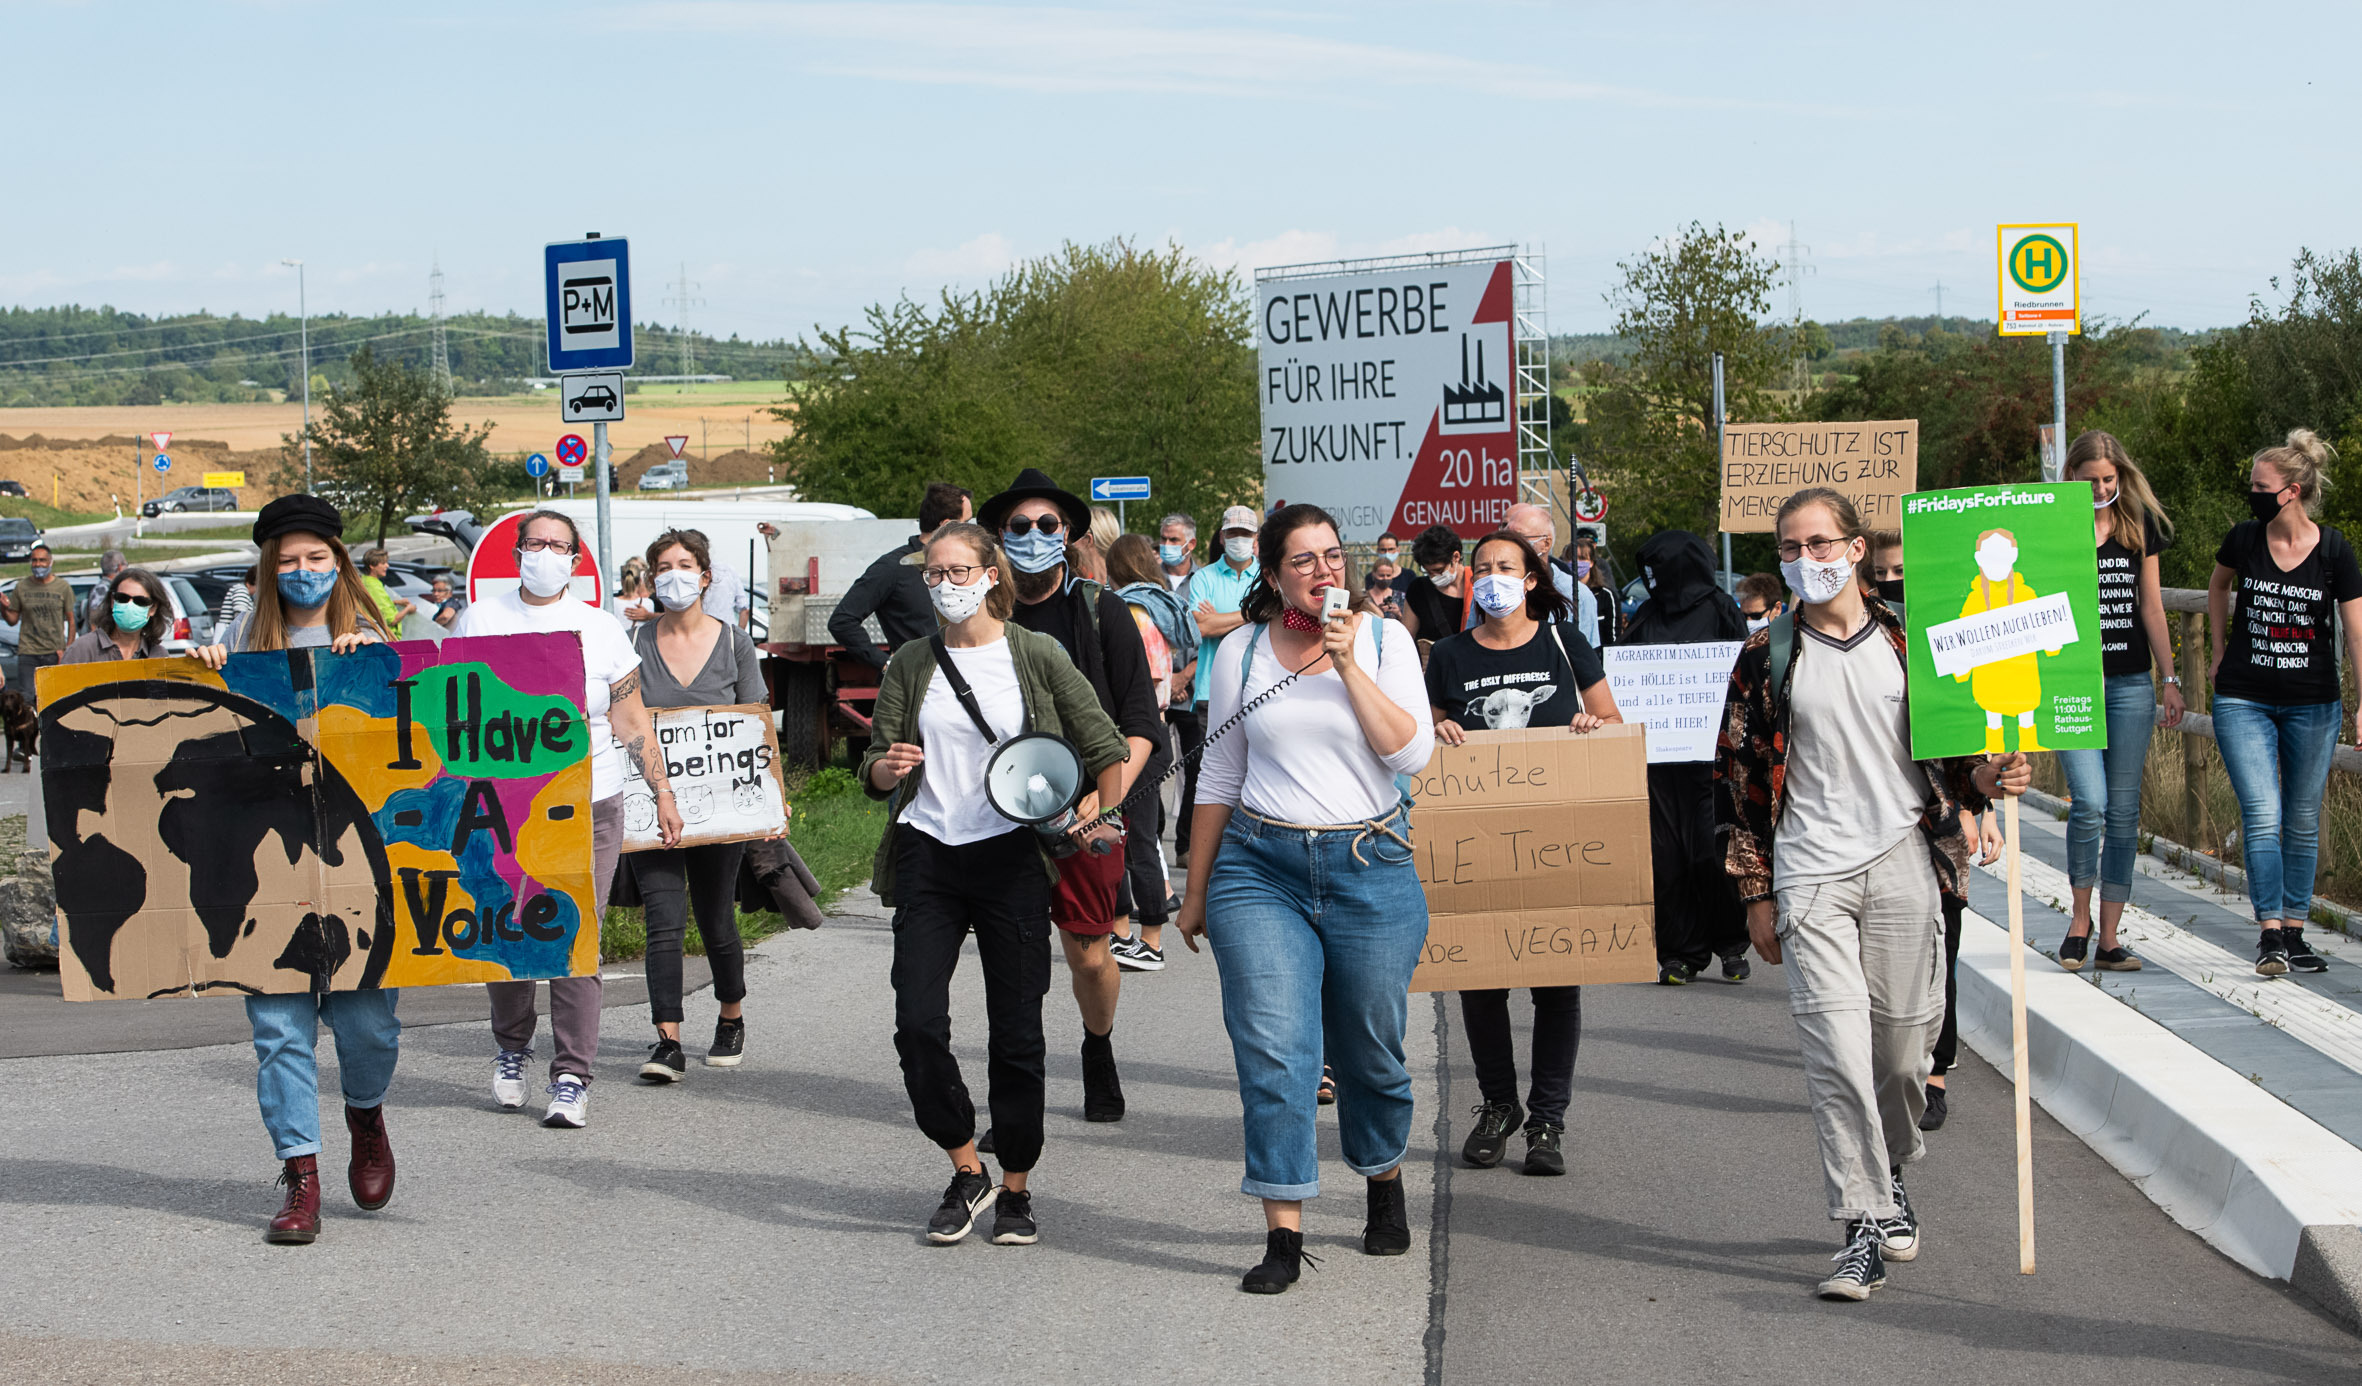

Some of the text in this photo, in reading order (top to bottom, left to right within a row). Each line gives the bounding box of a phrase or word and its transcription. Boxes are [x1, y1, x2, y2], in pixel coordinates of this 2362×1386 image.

[2026, 248, 2052, 279] H
[564, 286, 614, 324] P+M
[1266, 282, 1449, 344] GEWERBE
[1268, 358, 1396, 404] FÜR IHRE
[1270, 421, 1413, 465] ZUKUNFT.
[1726, 430, 1909, 457] TIERSCHUTZ IST
[1439, 447, 1513, 488] 20 ha
[1727, 459, 1900, 487] ERZIEHUNG ZUR
[1403, 500, 1466, 526] GENAU
[1908, 491, 2055, 514] #FridaysForFuture
[2099, 558, 2129, 568] UND DEN
[2101, 588, 2121, 599] KANN
[2244, 577, 2323, 601] SO LANGE MENSCHEN
[2111, 603, 2125, 614] WIE
[2262, 611, 2287, 623] NICHT
[2287, 601, 2307, 612] DASS
[1933, 604, 2068, 654] WIR WOLLEN AUCH LEBEN!
[2107, 643, 2128, 651] GANDHI
[2252, 638, 2309, 653] DASS MENSCHEN
[2251, 653, 2309, 668] NICHT DENKEN!
[1464, 671, 1551, 692] THE ONLY DIFFERENCE
[1614, 675, 1634, 687] Die
[1641, 672, 1675, 686] HÖLLE
[1679, 674, 1697, 685] ist
[1618, 692, 1719, 707] und alle TEUFEL
[2053, 696, 2093, 705] Freitags
[2054, 704, 2092, 714] 11:00 Uhr
[387, 671, 573, 770] I Have
[701, 709, 744, 741] for
[1675, 715, 1708, 729] HIER!
[2054, 714, 2093, 723] Rathaus-
[2055, 724, 2093, 734] Stuttgart
[1656, 745, 1693, 753] Shakespeare
[664, 743, 774, 784] beings
[450, 781, 513, 857] A
[1500, 829, 1611, 872] Tiere
[397, 867, 566, 956] Voice
[1504, 923, 1636, 962] VEGAN
